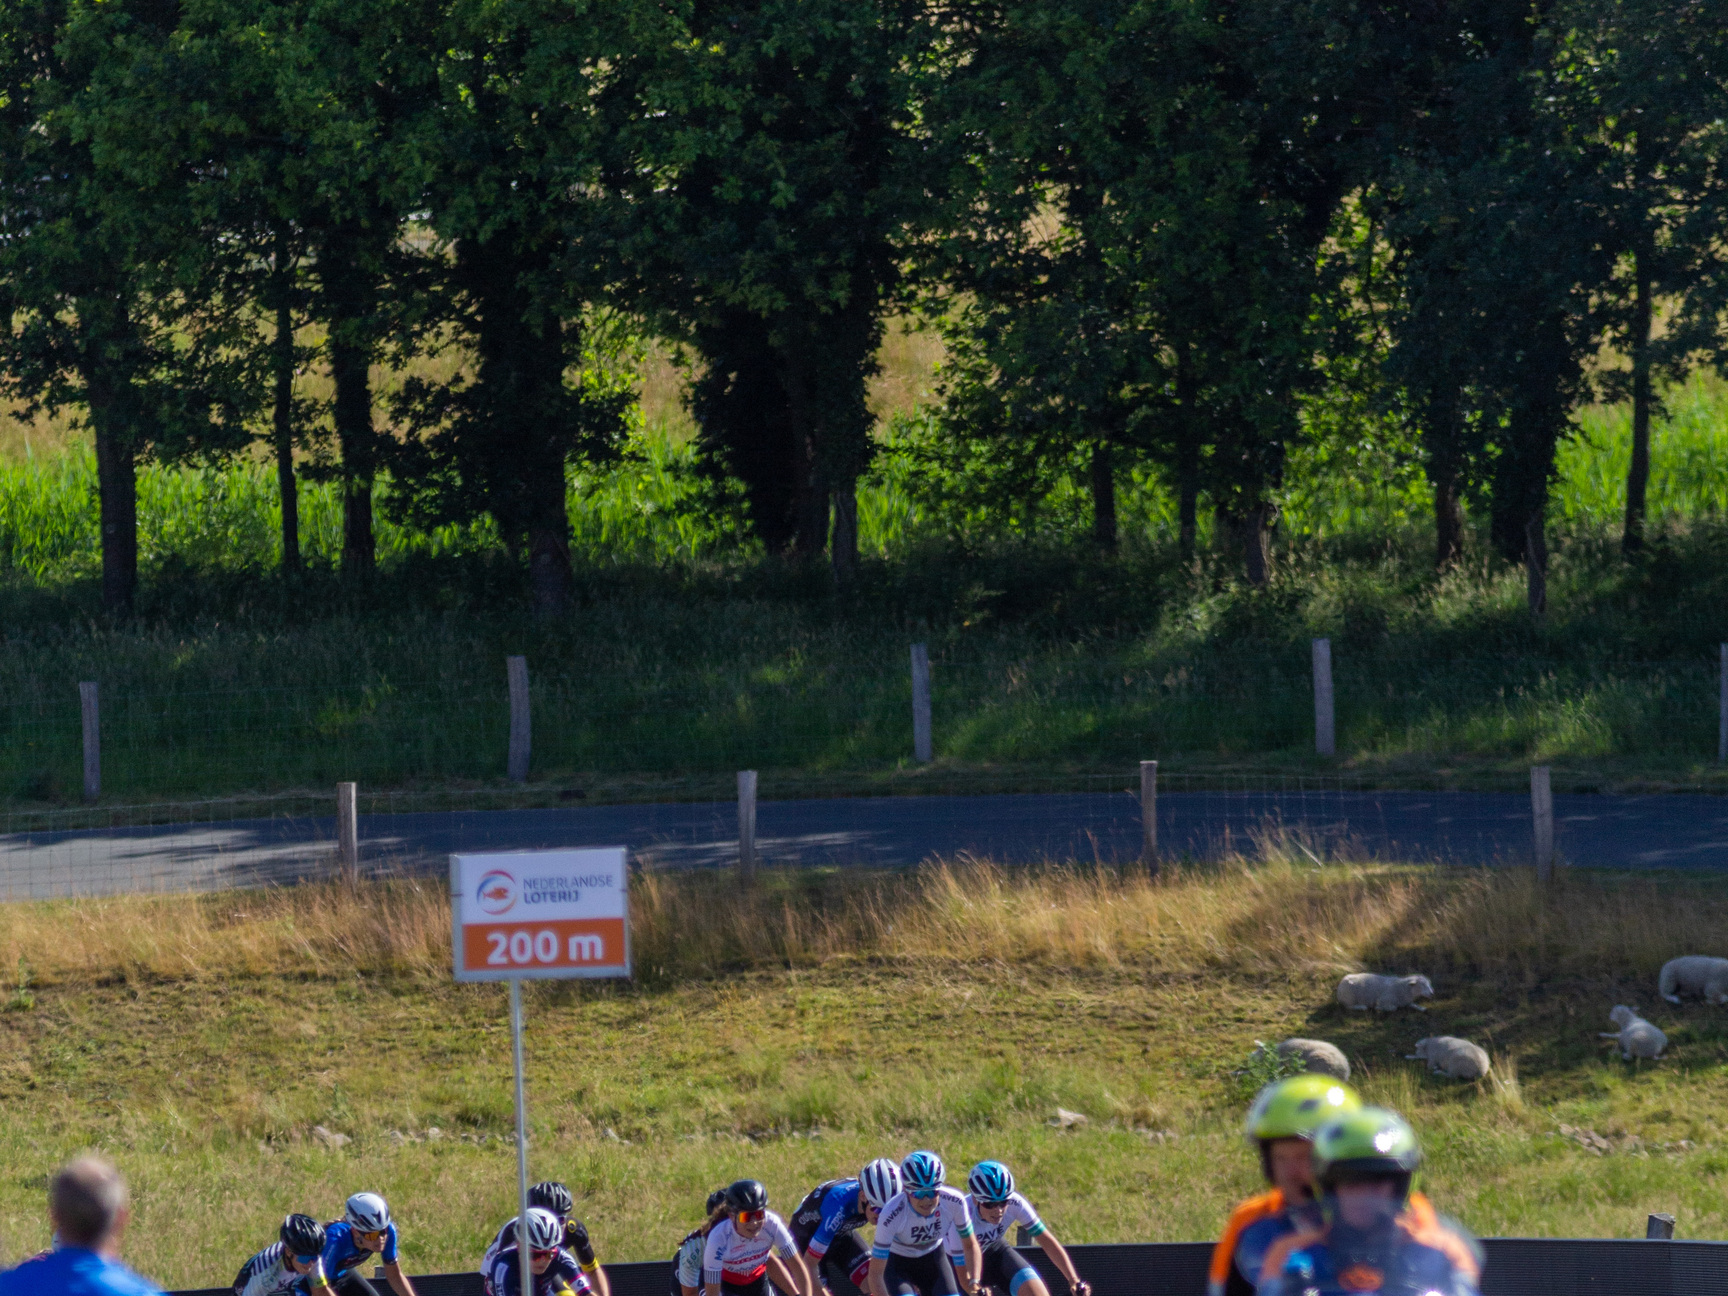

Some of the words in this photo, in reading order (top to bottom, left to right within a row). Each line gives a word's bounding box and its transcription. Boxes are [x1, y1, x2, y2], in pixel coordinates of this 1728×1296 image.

[523, 875, 613, 889] NEDERLANDSE
[524, 890, 579, 904] LOTERIJ
[487, 931, 558, 964] 200
[568, 935, 602, 960] m
[911, 1219, 941, 1234] PAVÉ
